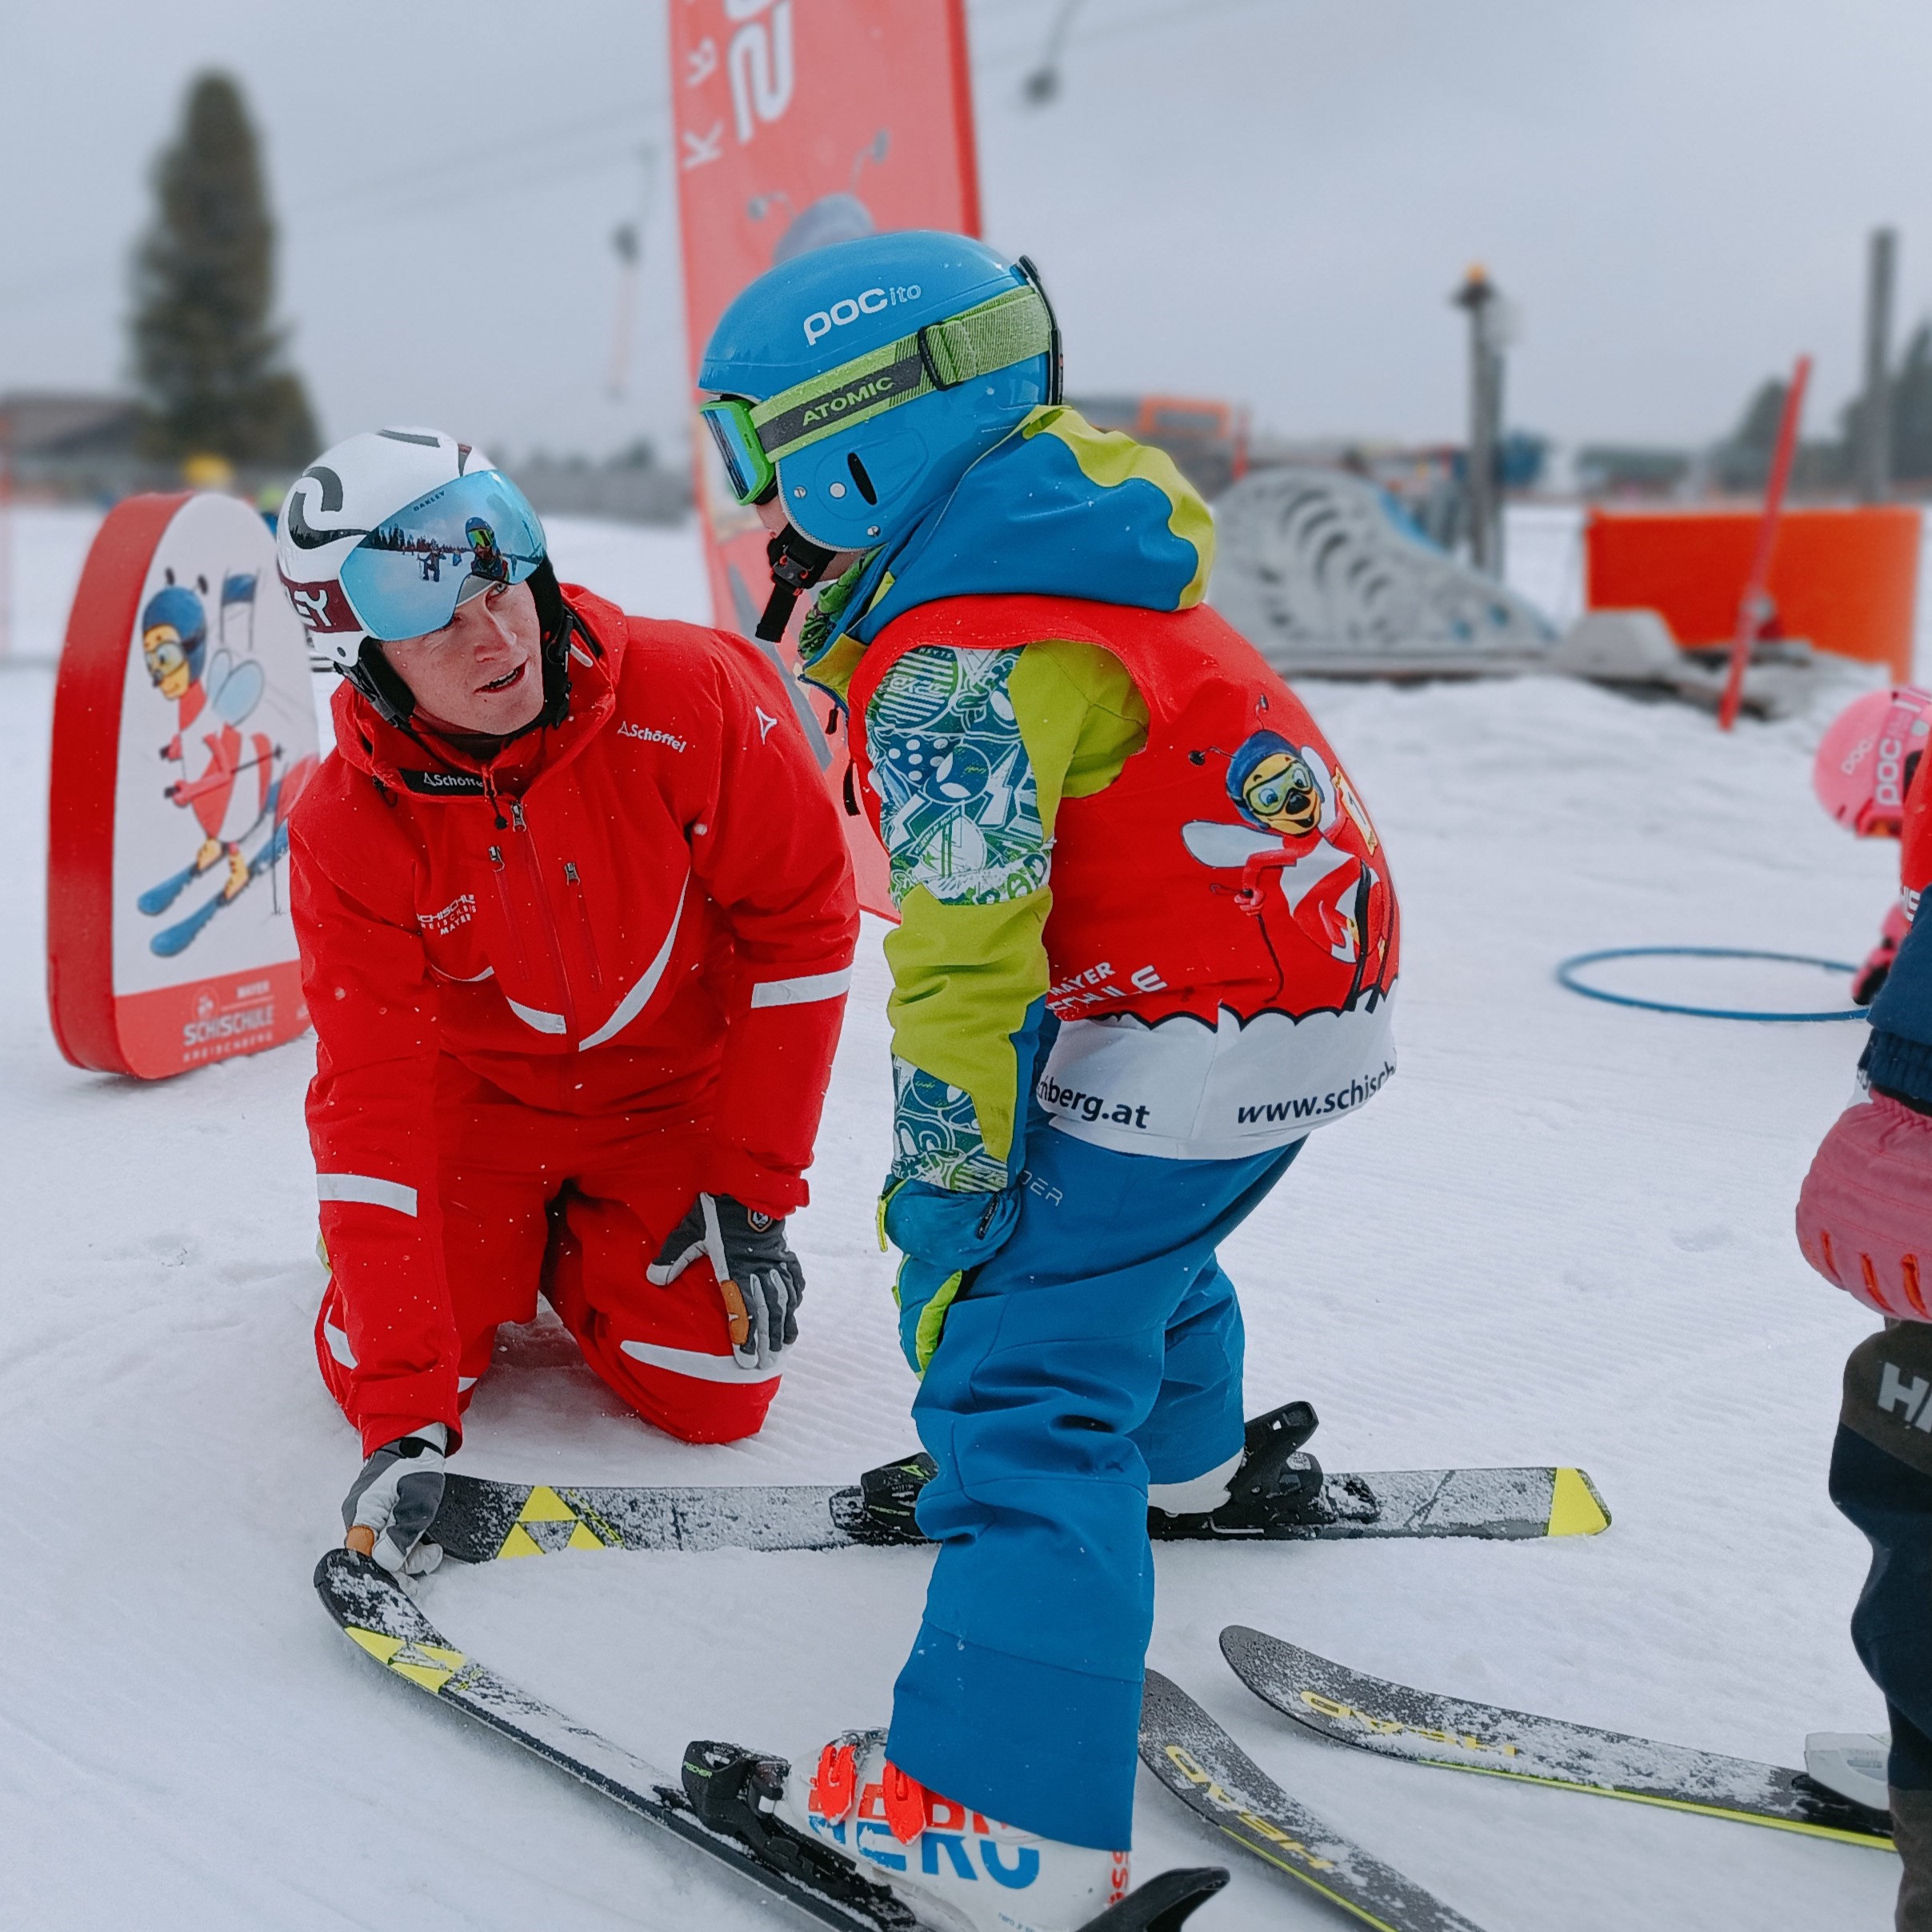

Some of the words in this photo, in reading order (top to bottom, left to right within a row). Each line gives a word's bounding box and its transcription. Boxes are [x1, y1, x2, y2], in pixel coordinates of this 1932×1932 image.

[802, 377, 894, 426] ATOMIC
[413, 490, 446, 512] OAKLEY
[630, 723, 687, 753] Schöffel
[1875, 737, 1902, 806] POC
[1048, 962, 1116, 996] MAYER
[183, 1004, 274, 1046] SCHISCHULE
